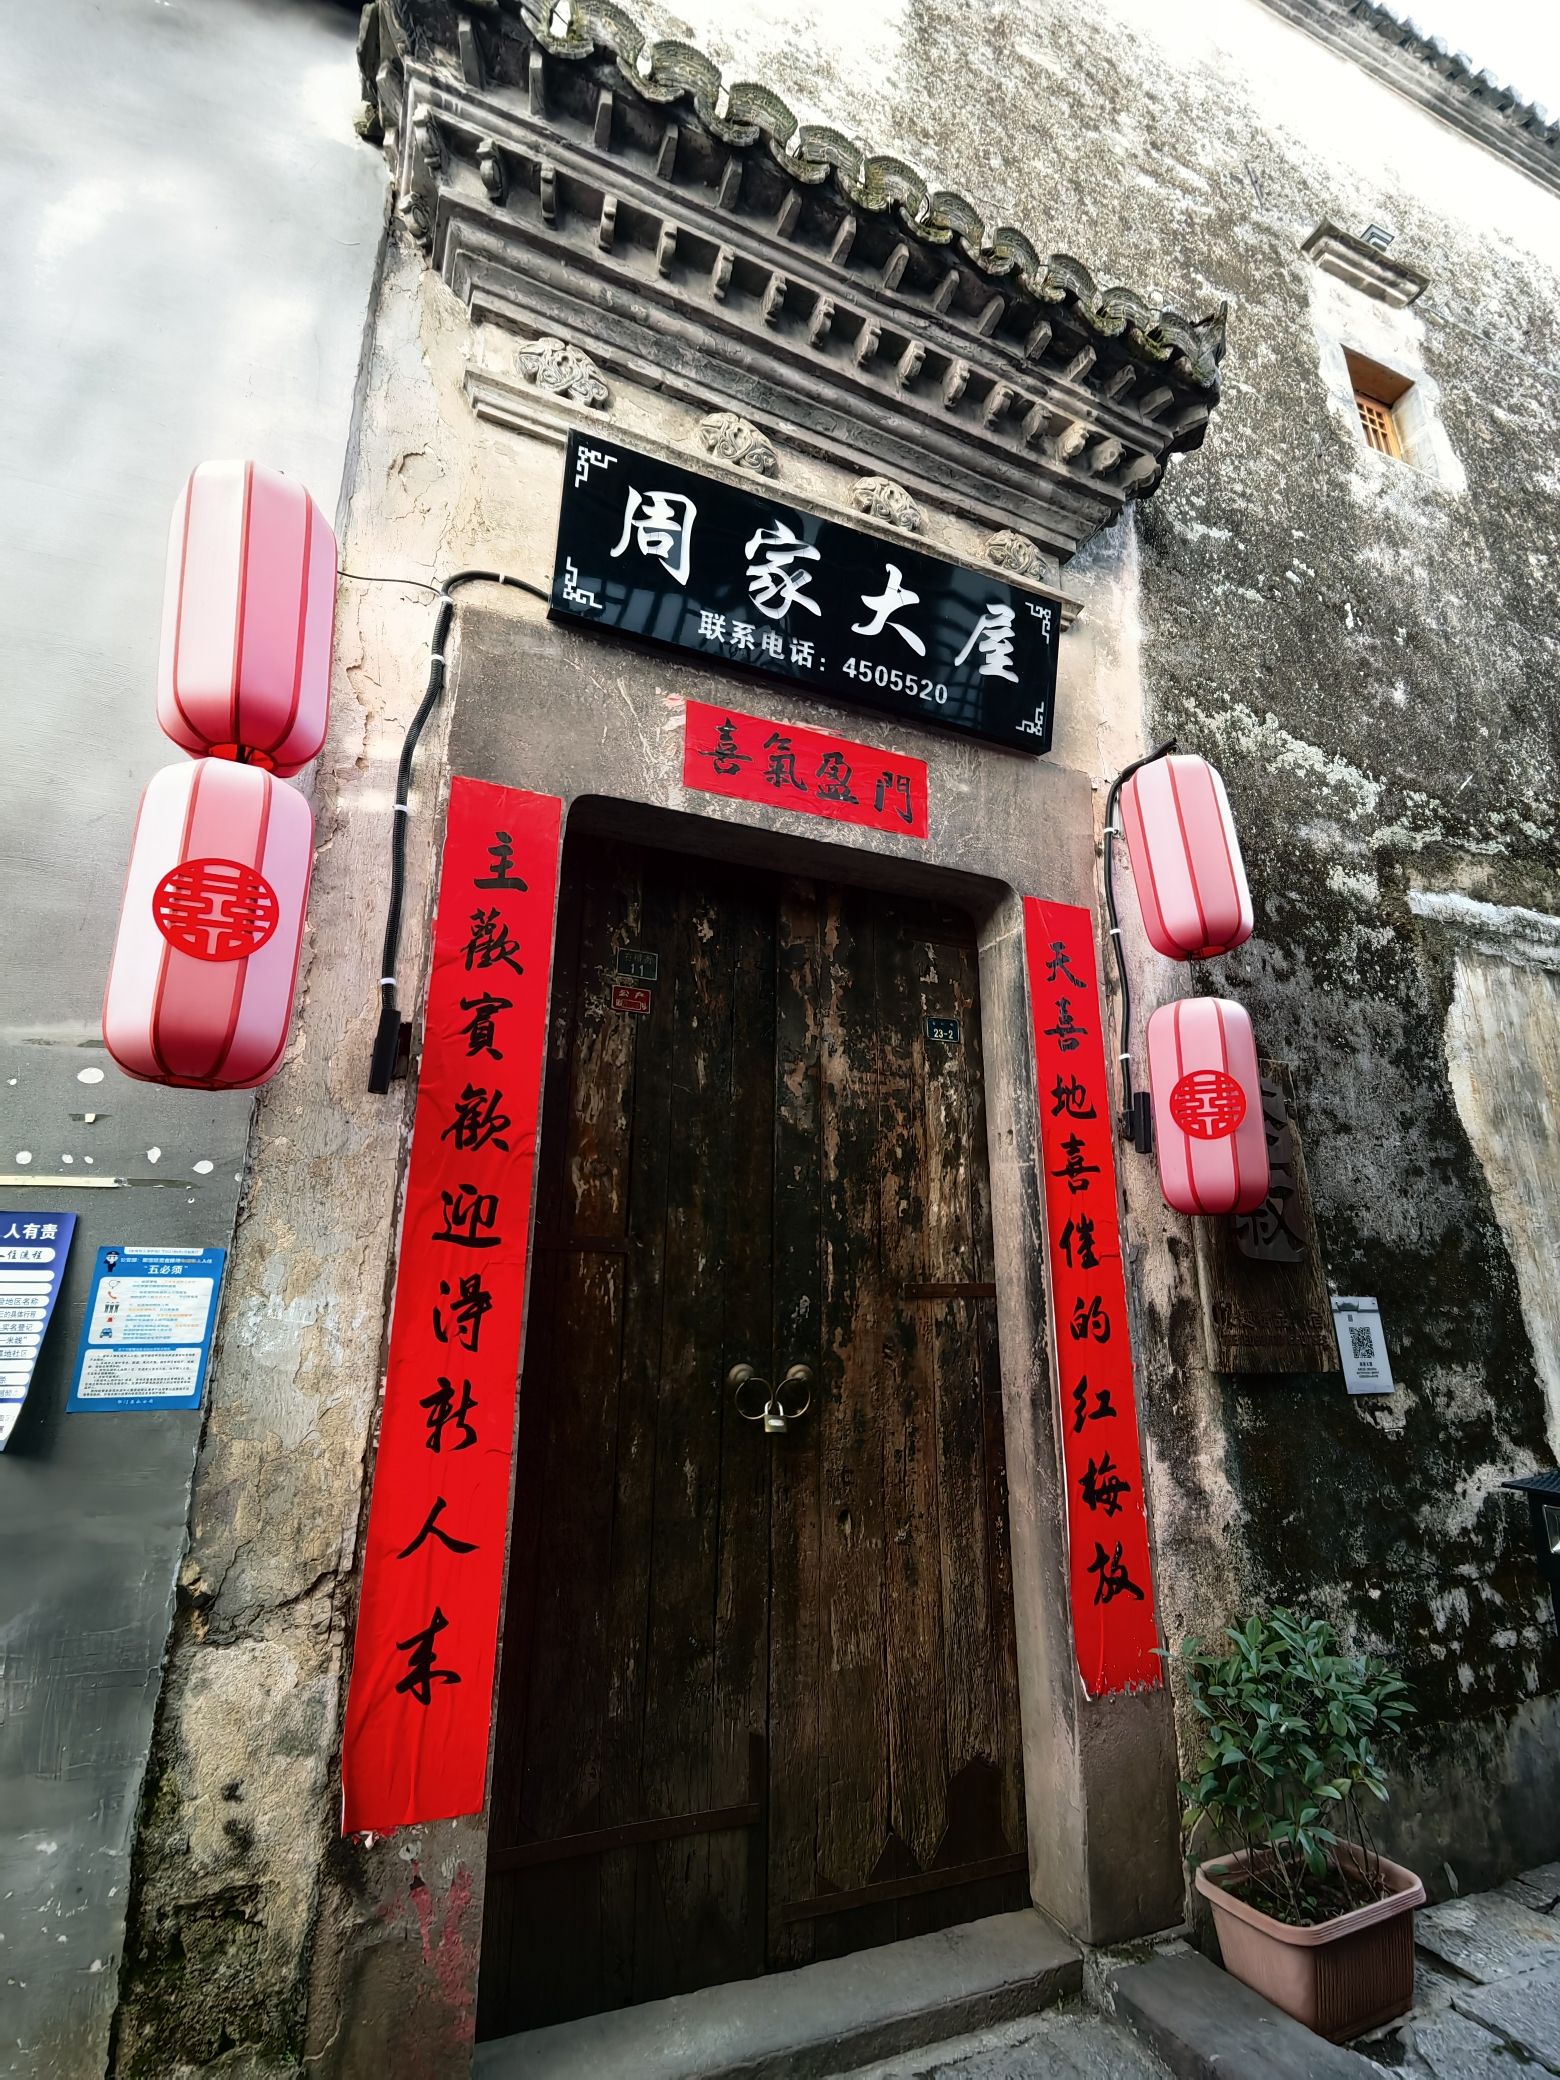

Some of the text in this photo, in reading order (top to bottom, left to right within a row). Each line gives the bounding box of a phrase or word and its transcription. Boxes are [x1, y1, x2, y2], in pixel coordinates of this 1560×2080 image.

[610, 485, 1019, 684] 周家大屋
[700, 717, 913, 824] 喜氣盈門
[933, 1028, 954, 1040] 23-2
[3, 1223, 58, 1240] 人有责
[0, 1323, 33, 1331] 实名登记
